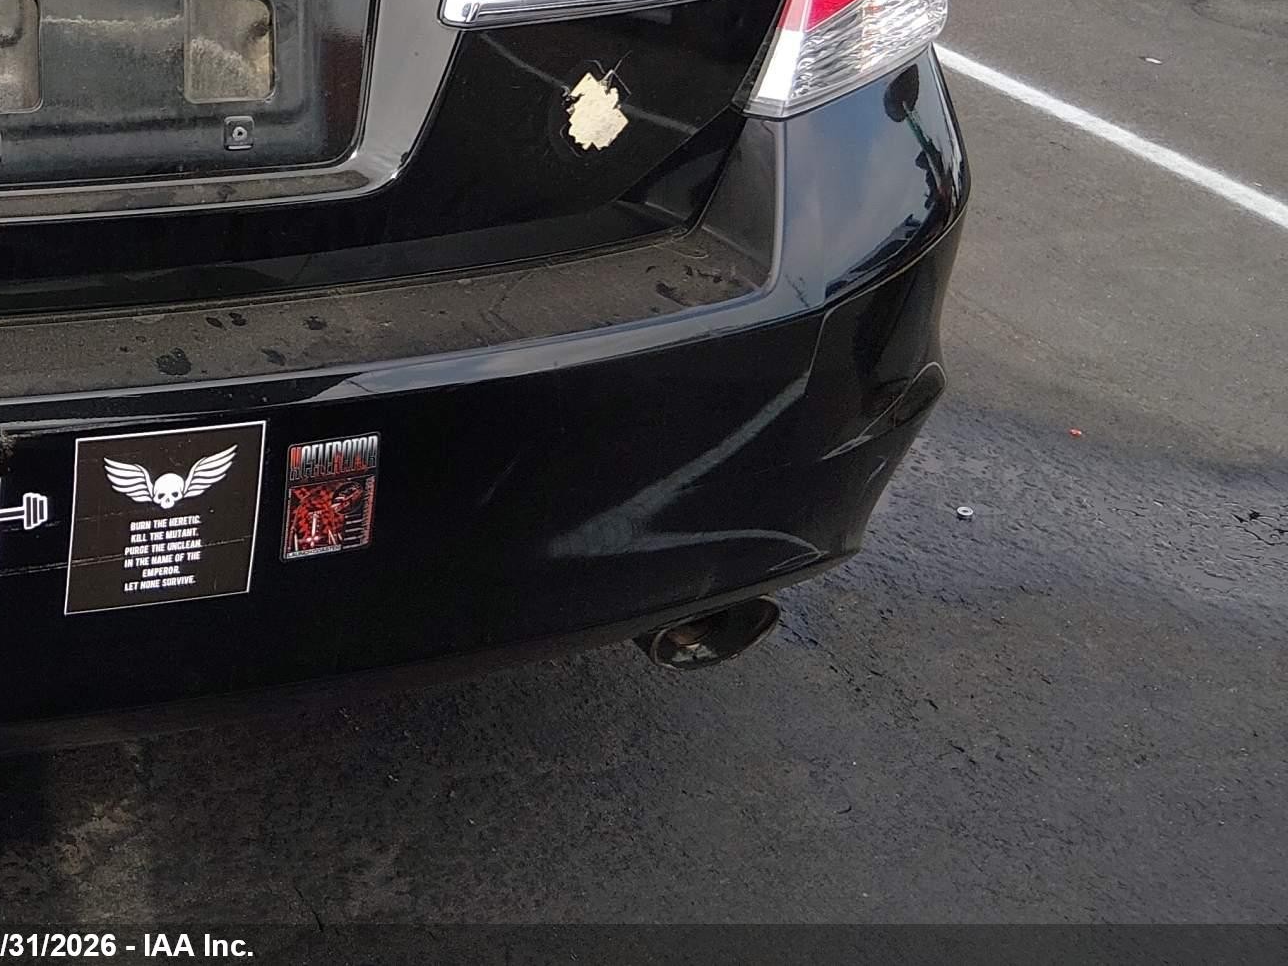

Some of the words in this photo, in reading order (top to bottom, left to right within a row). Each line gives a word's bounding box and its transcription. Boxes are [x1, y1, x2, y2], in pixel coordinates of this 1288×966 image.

[130, 521, 151, 531] BURN
[153, 519, 168, 528] THE
[169, 515, 202, 526] HERETIC.
[131, 533, 147, 543] KILL
[150, 532, 164, 541] THE
[166, 528, 199, 539] MUTANT.
[125, 545, 149, 555] PURGE
[152, 544, 166, 552] THE
[124, 559, 133, 568] IN
[136, 557, 150, 566] THE
[152, 554, 173, 564] NAME
[175, 553, 185, 562] OF
[187, 551, 201, 560] THE
[142, 566, 180, 577] EMPEROR.
[124, 582, 138, 591] LET
[140, 579, 161, 589] NONE
[162, 575, 196, 587] SURVIVE.
